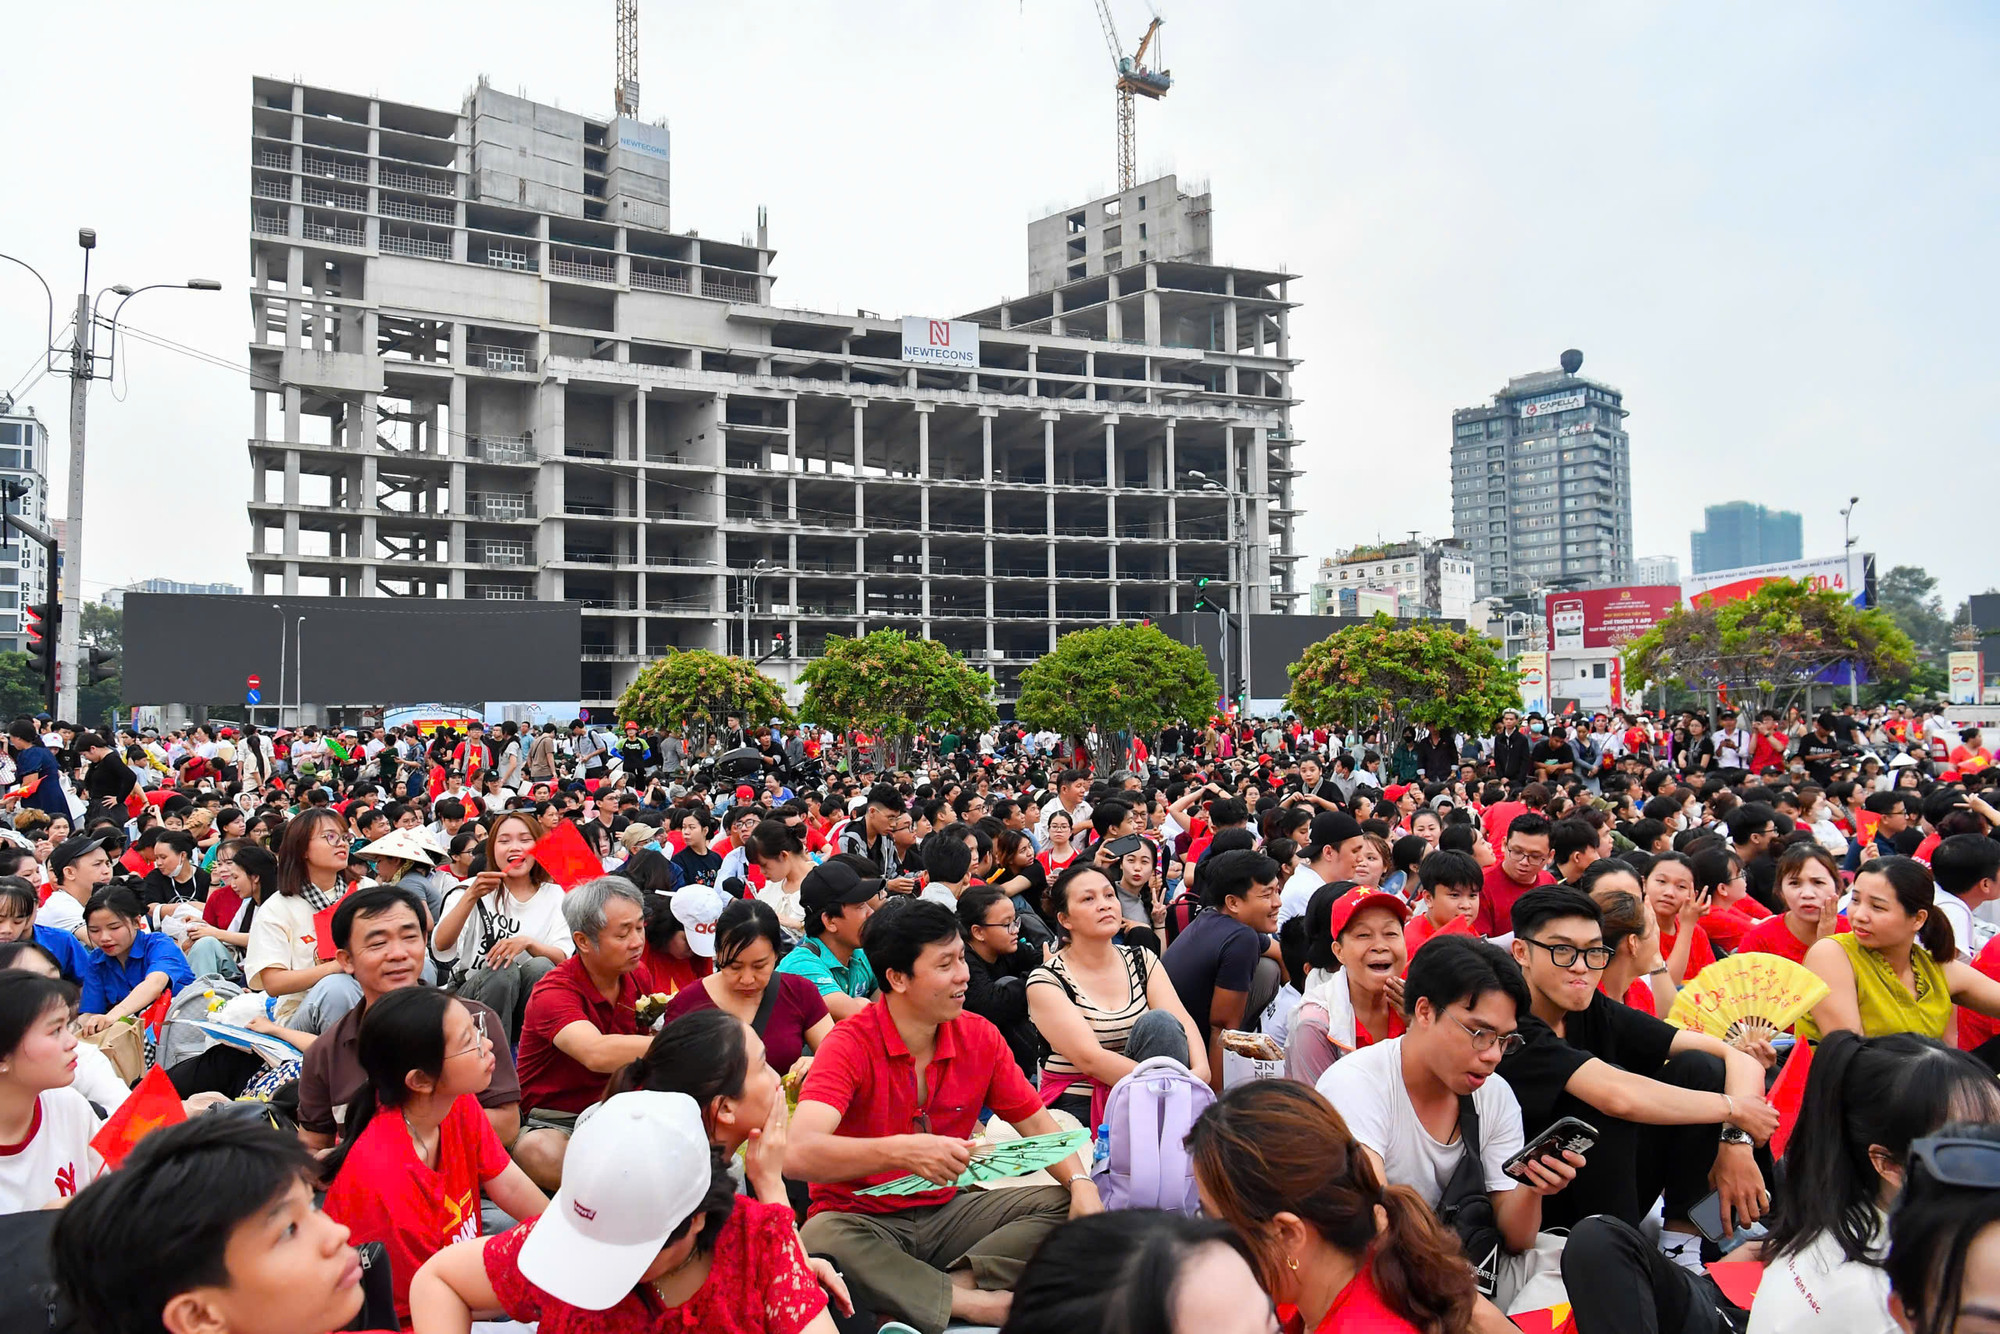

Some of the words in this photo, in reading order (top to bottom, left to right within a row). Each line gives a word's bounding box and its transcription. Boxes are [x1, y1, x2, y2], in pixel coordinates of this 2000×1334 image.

[620, 137, 668, 156] NEWTECONS
[904, 345, 974, 361] NEWTECONS
[1540, 397, 1579, 410] CAPELLA
[489, 911, 521, 933] YOU
